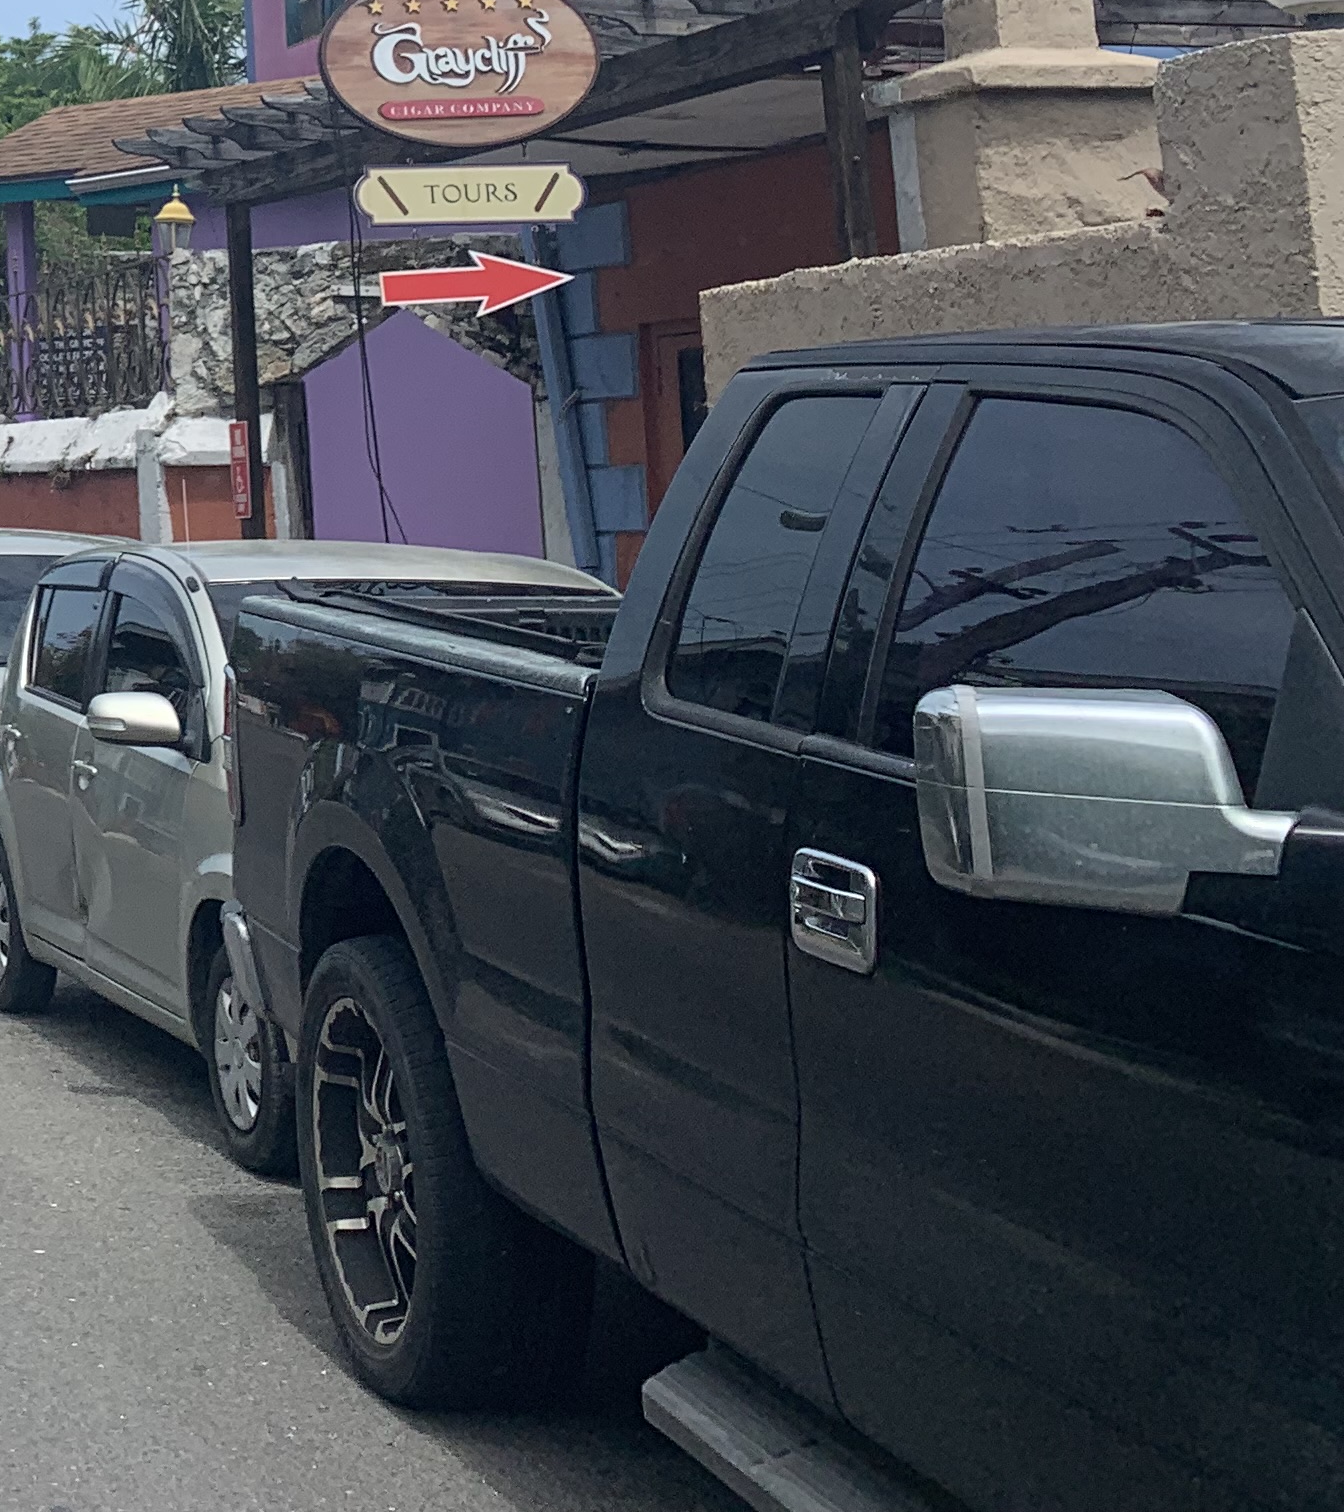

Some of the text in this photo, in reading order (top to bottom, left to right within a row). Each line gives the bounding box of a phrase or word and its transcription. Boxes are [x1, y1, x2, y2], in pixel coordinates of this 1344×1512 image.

[372, 18, 543, 94] Graycliff
[390, 100, 535, 117] CIGAR COMPANY
[423, 182, 518, 204] TOURS
